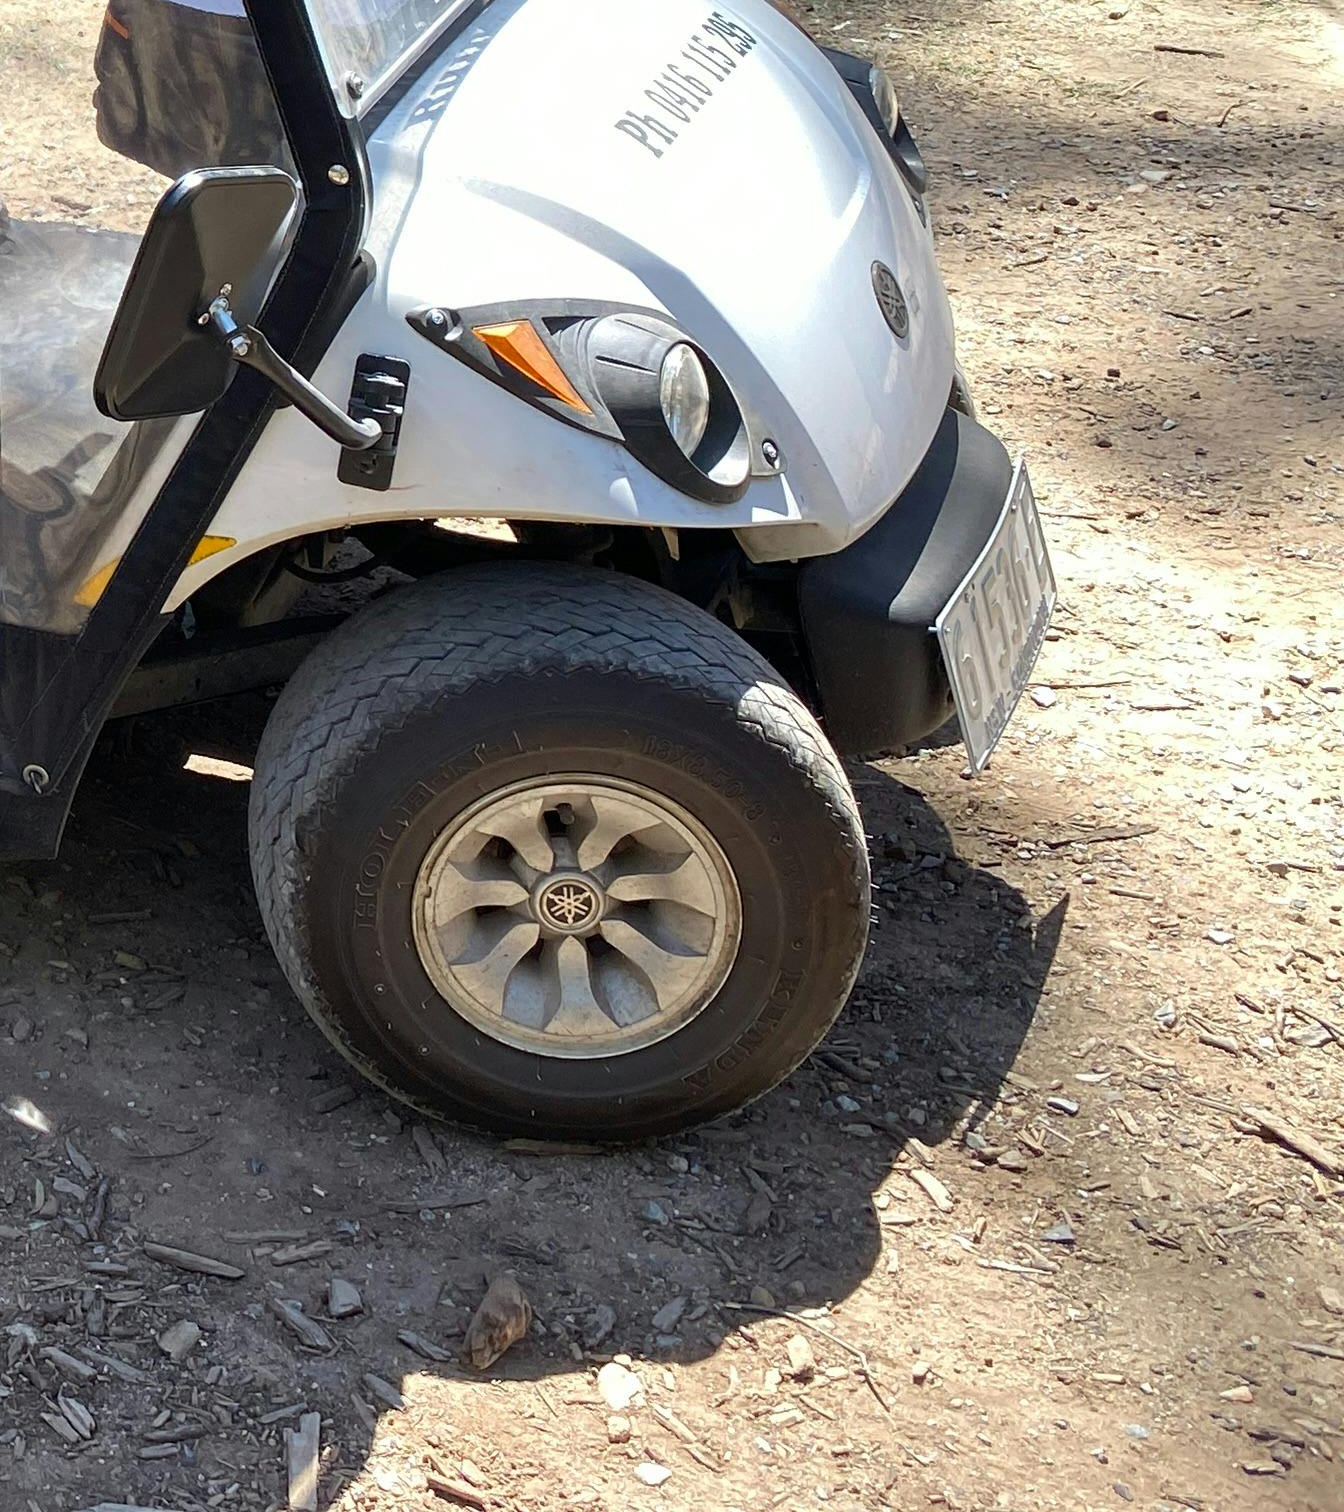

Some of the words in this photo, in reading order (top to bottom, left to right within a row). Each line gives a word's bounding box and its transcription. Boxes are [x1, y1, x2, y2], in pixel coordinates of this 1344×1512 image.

[680, 34, 737, 82] 115
[701, 11, 757, 57] 295
[643, 63, 713, 124] 0416
[614, 109, 678, 159] Ph
